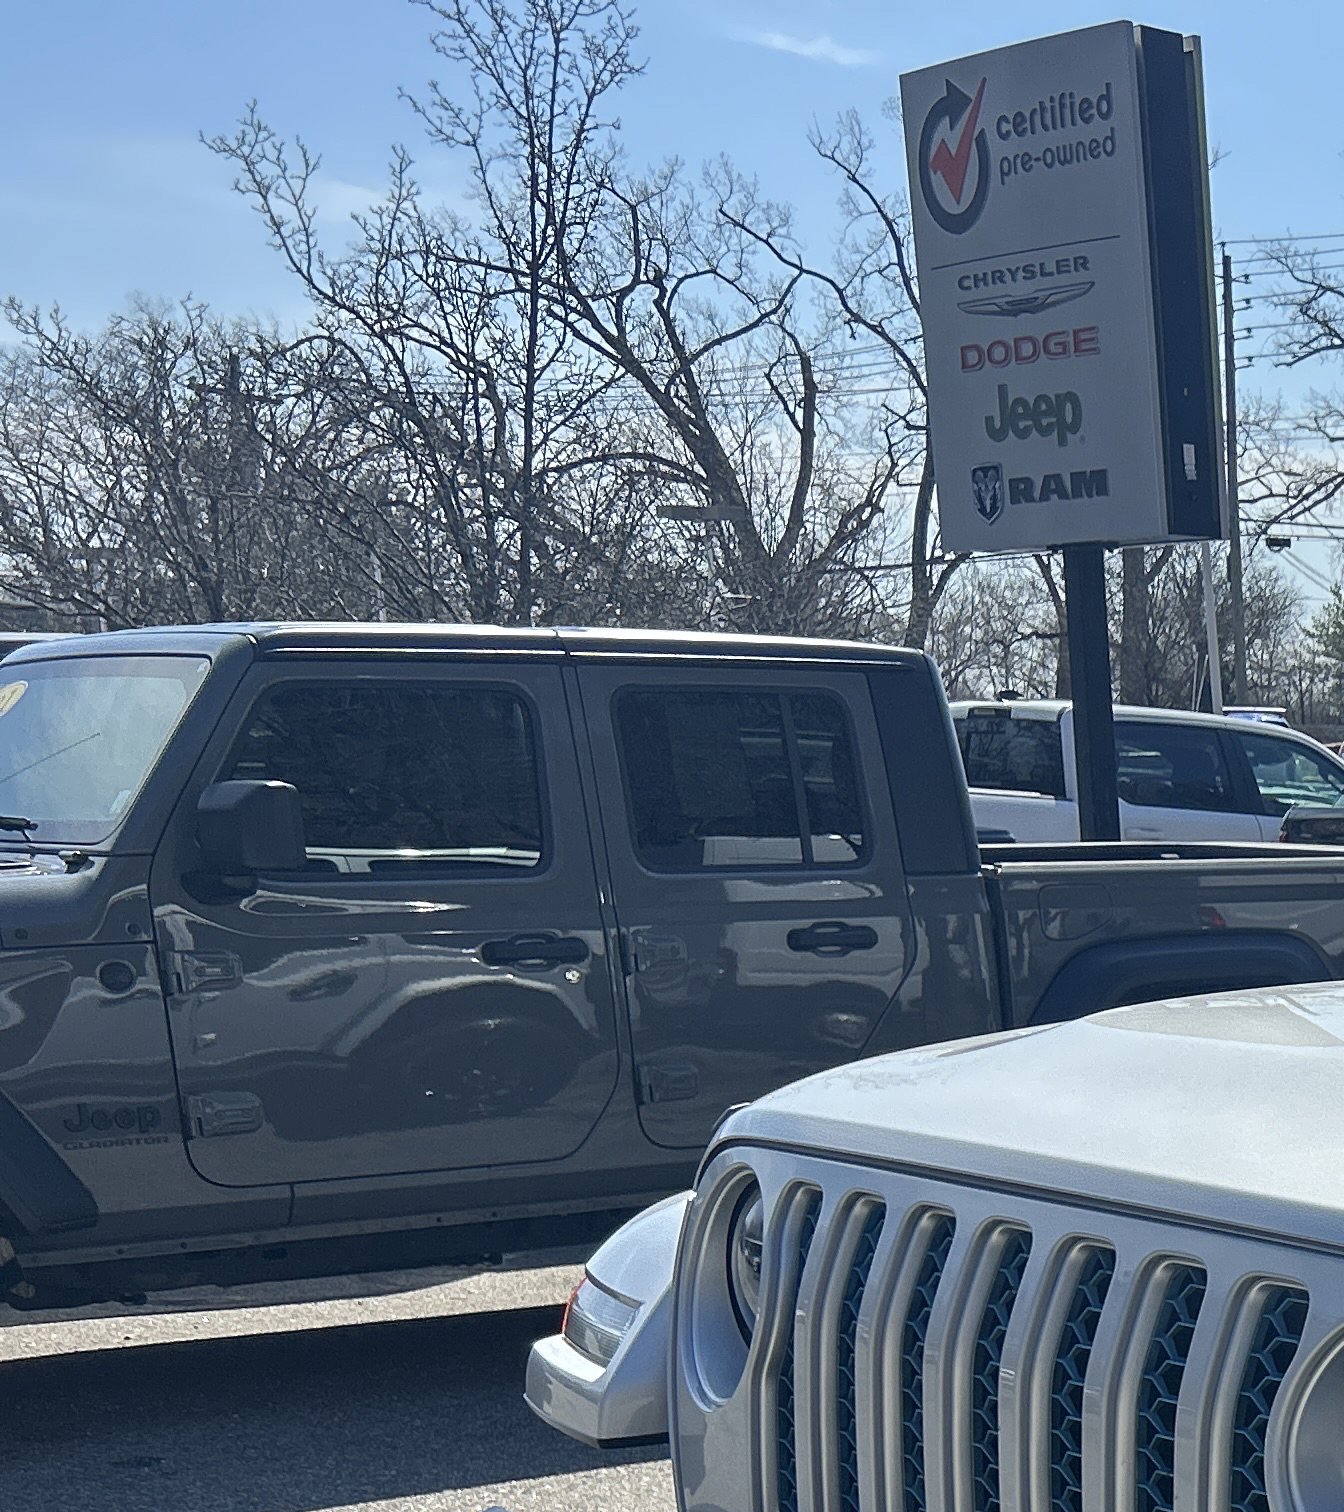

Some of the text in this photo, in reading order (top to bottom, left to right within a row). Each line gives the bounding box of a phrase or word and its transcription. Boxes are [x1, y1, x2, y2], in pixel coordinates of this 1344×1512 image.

[996, 82, 1113, 142] certified
[999, 127, 1117, 186] pre-owned
[957, 255, 1091, 291] CHRYSLER
[960, 326, 1100, 373] DODGE
[985, 384, 1083, 447] Jeep
[1008, 468, 1110, 506] RAM
[63, 1102, 162, 1133] Jeep
[63, 1135, 169, 1151] GLADIATOR
